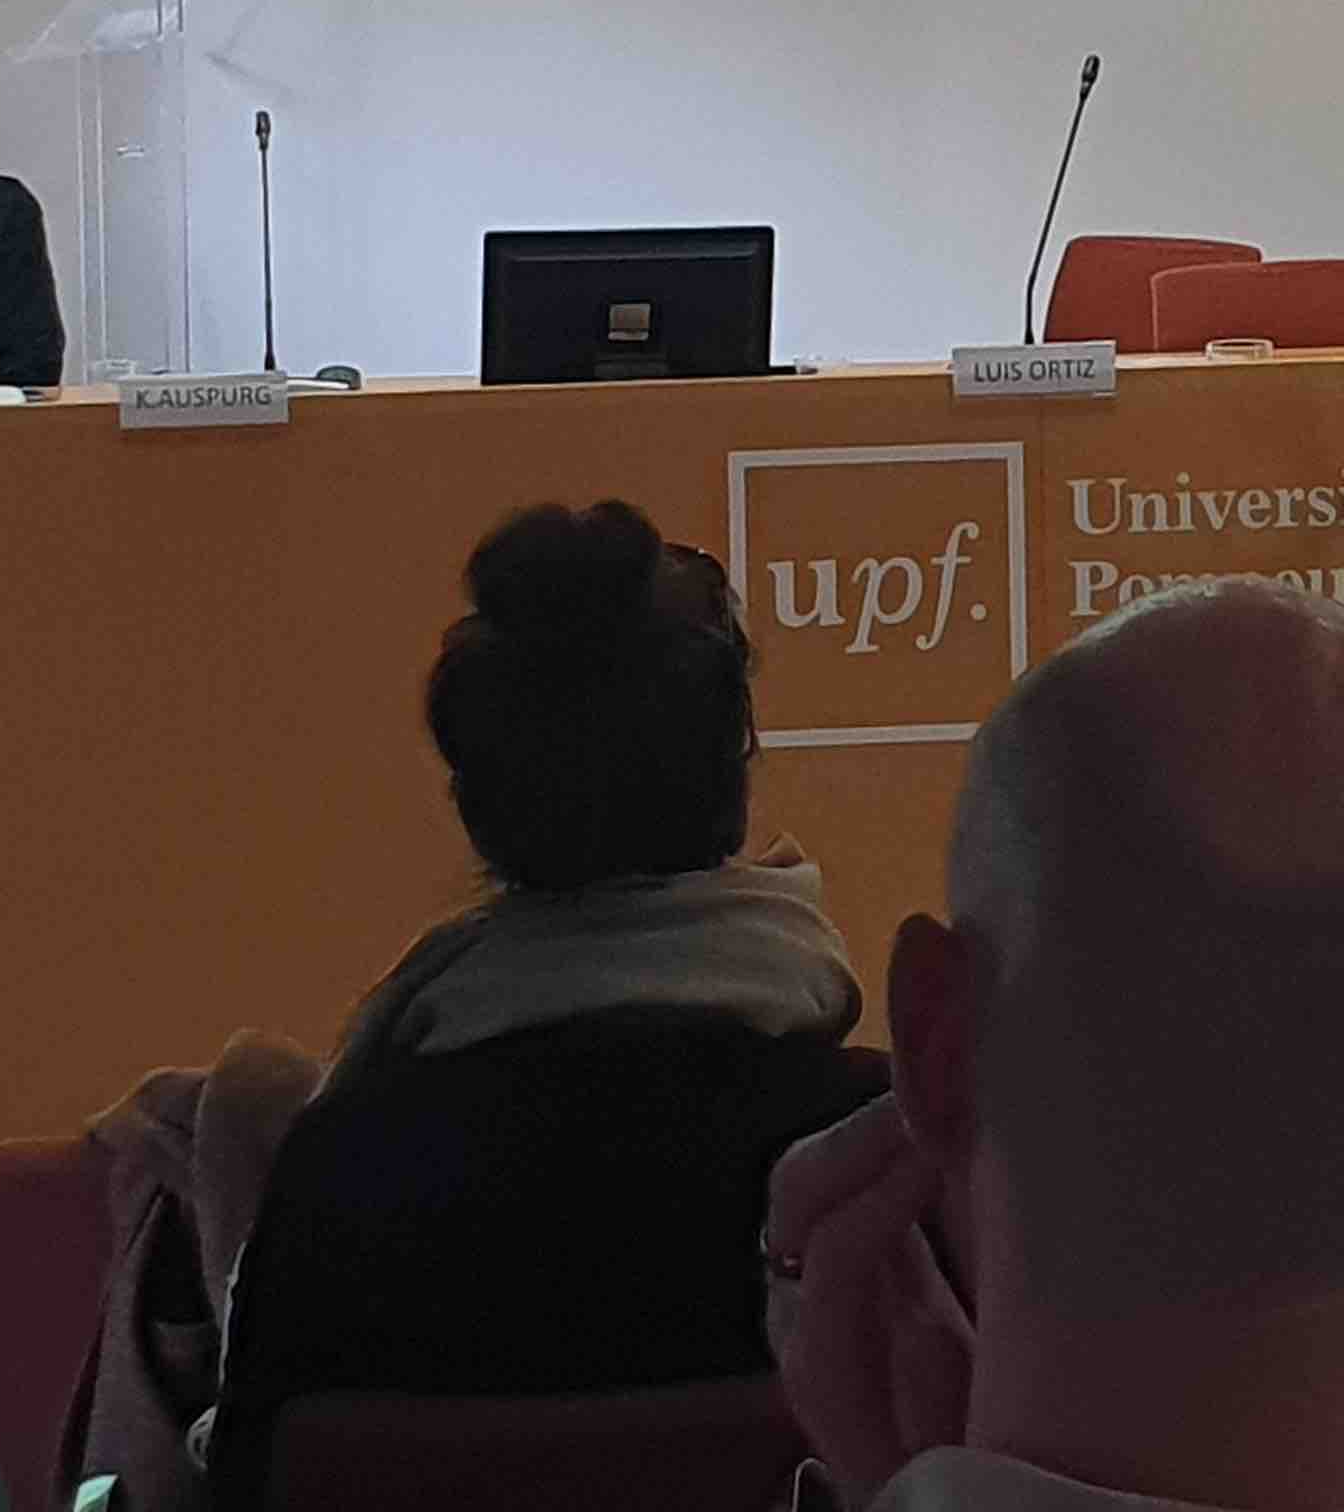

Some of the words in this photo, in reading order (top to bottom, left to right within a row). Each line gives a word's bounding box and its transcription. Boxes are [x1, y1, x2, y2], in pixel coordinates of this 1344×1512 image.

[973, 360, 1023, 383] LUIS
[1028, 358, 1096, 381] ORTIZ
[766, 520, 988, 654] upf.
